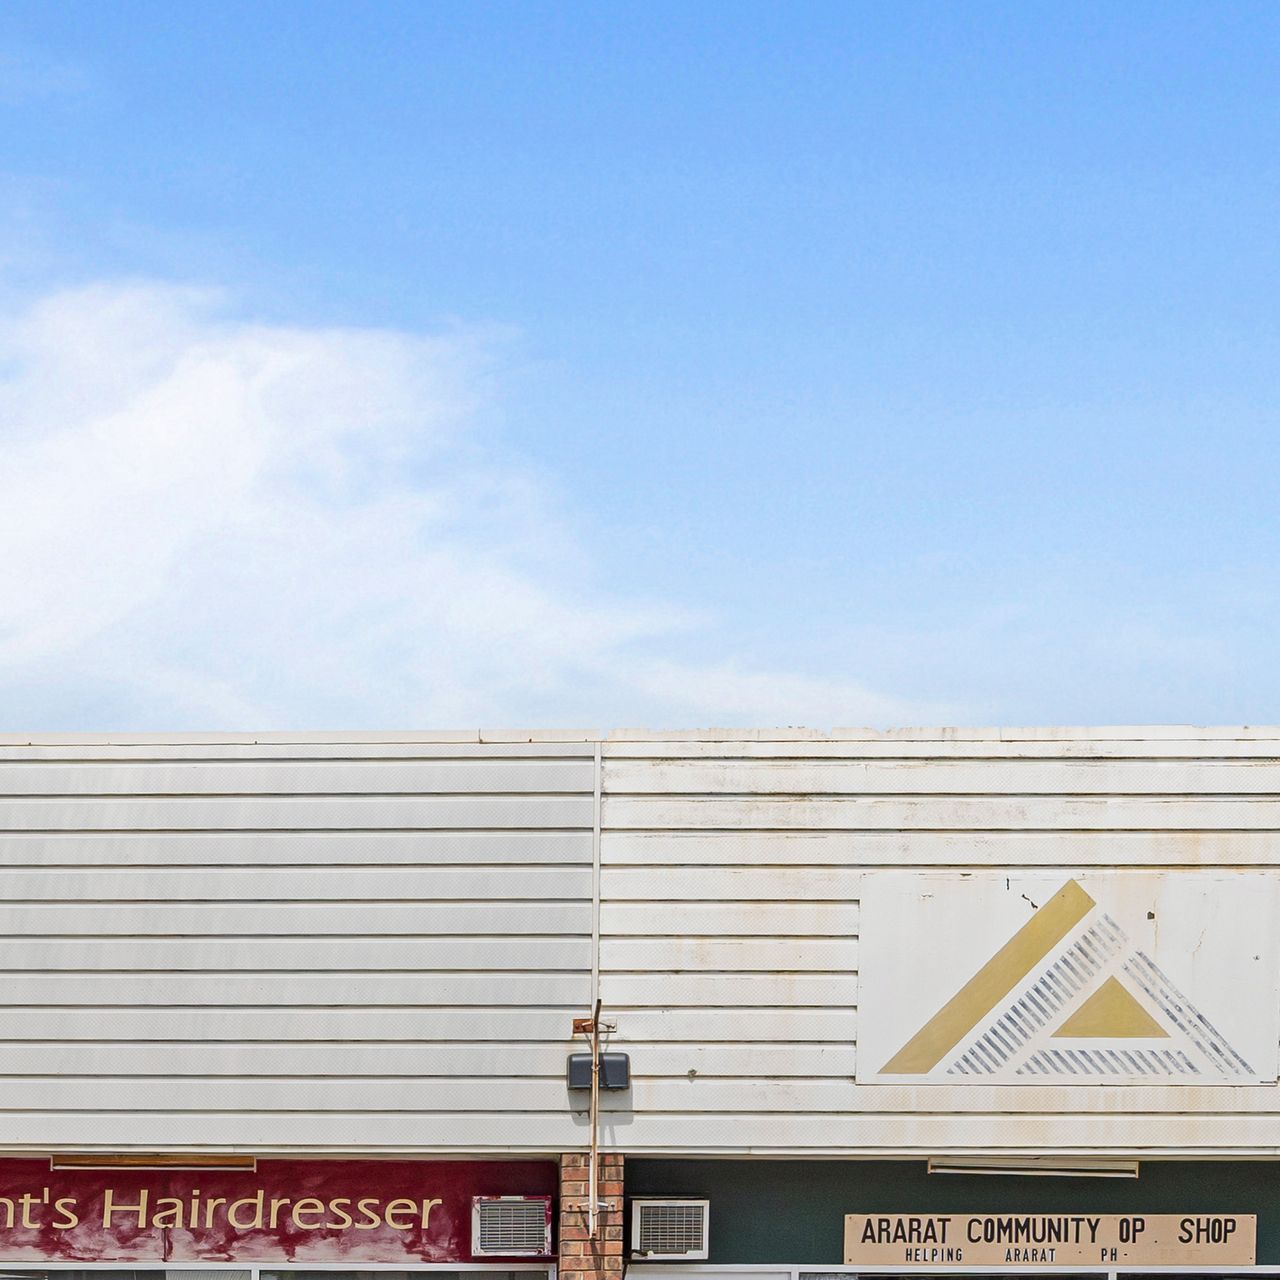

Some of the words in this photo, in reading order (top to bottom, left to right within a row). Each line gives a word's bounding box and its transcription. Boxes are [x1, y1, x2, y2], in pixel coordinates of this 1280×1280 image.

[102, 1189, 443, 1231] Hairdresser
[861, 1217, 951, 1244] ARARAT
[966, 1217, 1101, 1244] COMMUNITY
[1177, 1217, 1237, 1244] SHOP
[905, 1248, 963, 1263] HELPING
[1005, 1248, 1056, 1263] ARARAT
